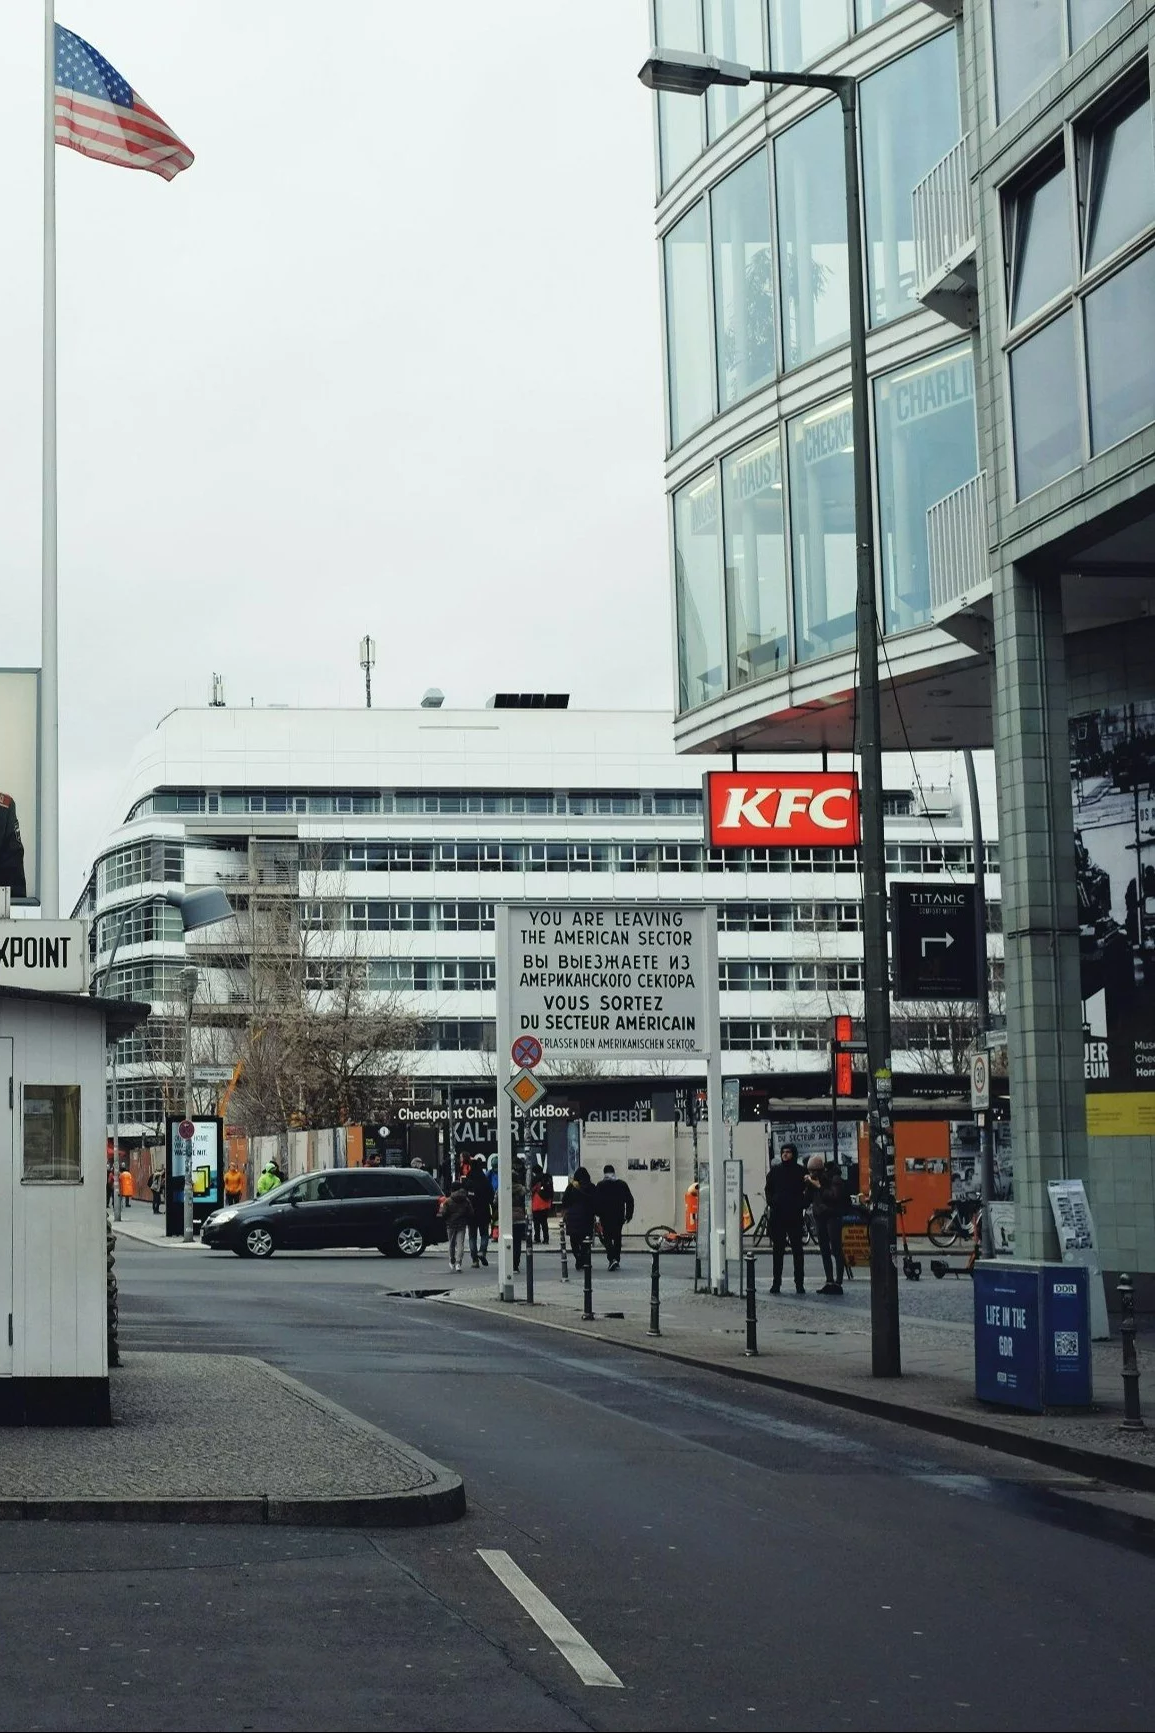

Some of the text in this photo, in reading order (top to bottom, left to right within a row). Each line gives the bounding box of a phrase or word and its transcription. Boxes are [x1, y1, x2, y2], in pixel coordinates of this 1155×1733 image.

[717, 788, 851, 829] KFC
[910, 893, 965, 904] TITANIC
[529, 911, 683, 927] YOU ARE LEAVING
[521, 930, 692, 946] THE AMERICAN SECTOR
[523, 955, 690, 970] ВЫ ВЫЕЗЖАЕТЕ ИЗ
[519, 973, 695, 988] АМЕРИКАНСКОГО СЕКТОРА
[544, 995, 663, 1011] VOUS SORTEZ
[520, 1012, 696, 1031] DU SECTEUR AMÉRICAIN
[537, 1037, 696, 1050] ERLASSEN DEN AMERIKANISCHEN SEKTOR
[398, 1106, 463, 1122] Checkpoint
[514, 1104, 570, 1118] BckBox
[1055, 1285, 1075, 1293] DDR
[985, 1304, 1026, 1329] LIFE IN THE
[998, 1336, 1013, 1358] GDR
